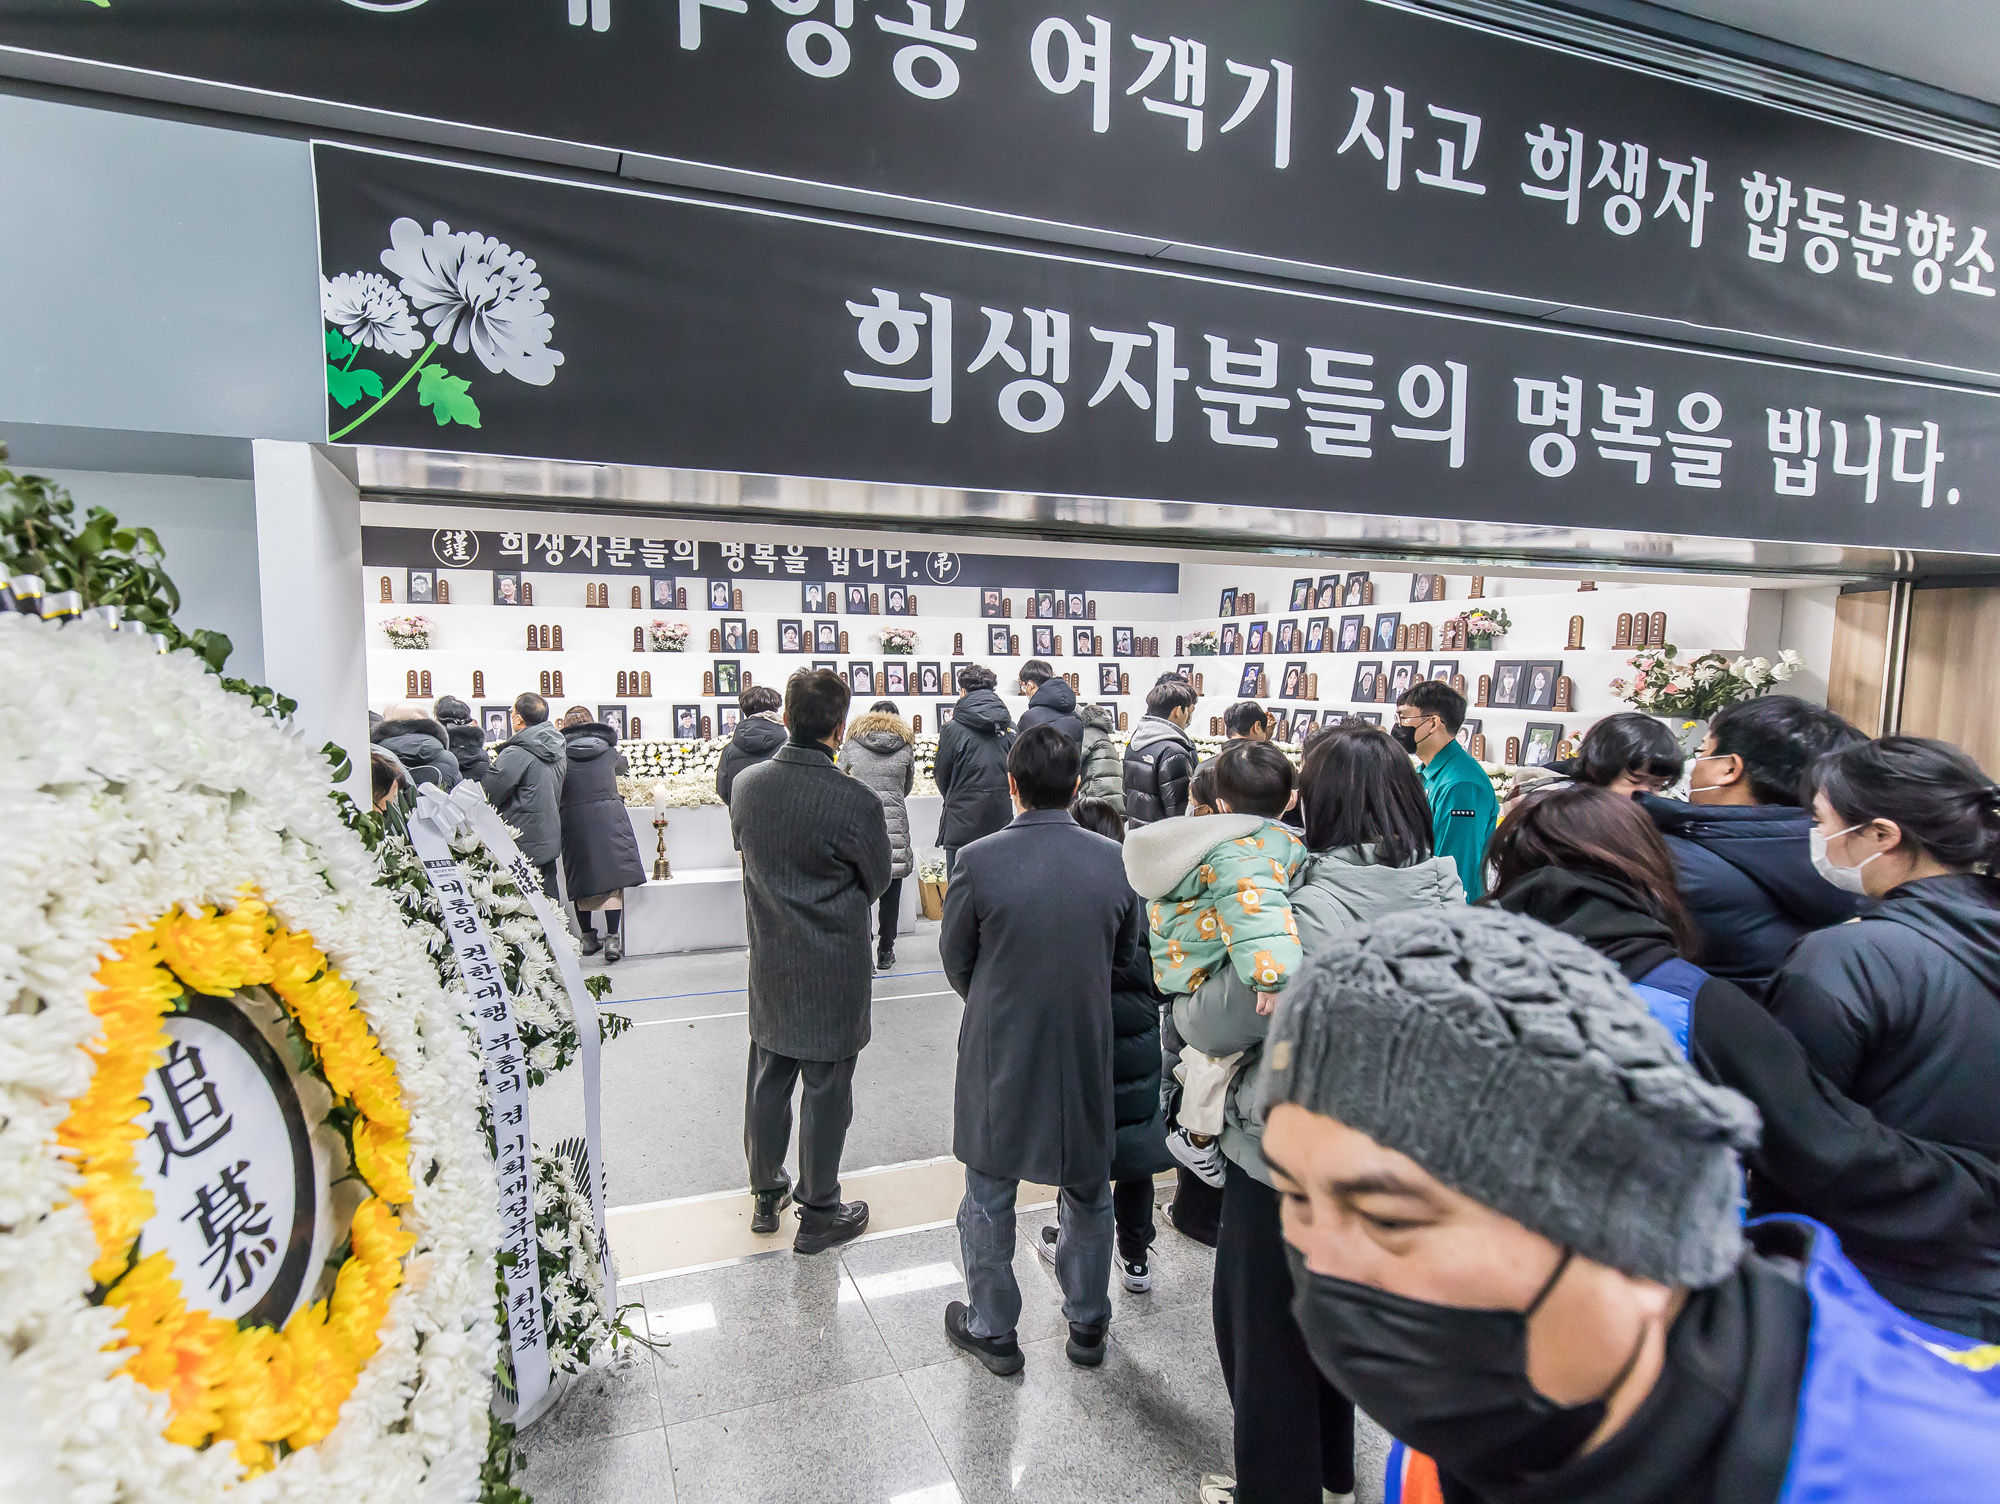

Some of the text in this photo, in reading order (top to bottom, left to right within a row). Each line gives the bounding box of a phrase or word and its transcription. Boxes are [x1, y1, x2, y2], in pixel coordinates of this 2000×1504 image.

[1030, 14, 1293, 170] 여객기
[1336, 85, 1487, 196] 사고
[1520, 123, 1715, 248] 희생자
[1740, 170, 1997, 298] 합동분향소
[844, 287, 1962, 509] 희생자분들의 명복을 빕니다.
[498, 531, 919, 579] 희생자분들의 명복을 빕니다.
[438, 879, 478, 935] 대통령
[460, 943, 508, 1023] 권한대행
[486, 1032, 524, 1094] 부총리
[500, 1103, 523, 1126] 겸
[511, 1285, 544, 1352] 최상목
